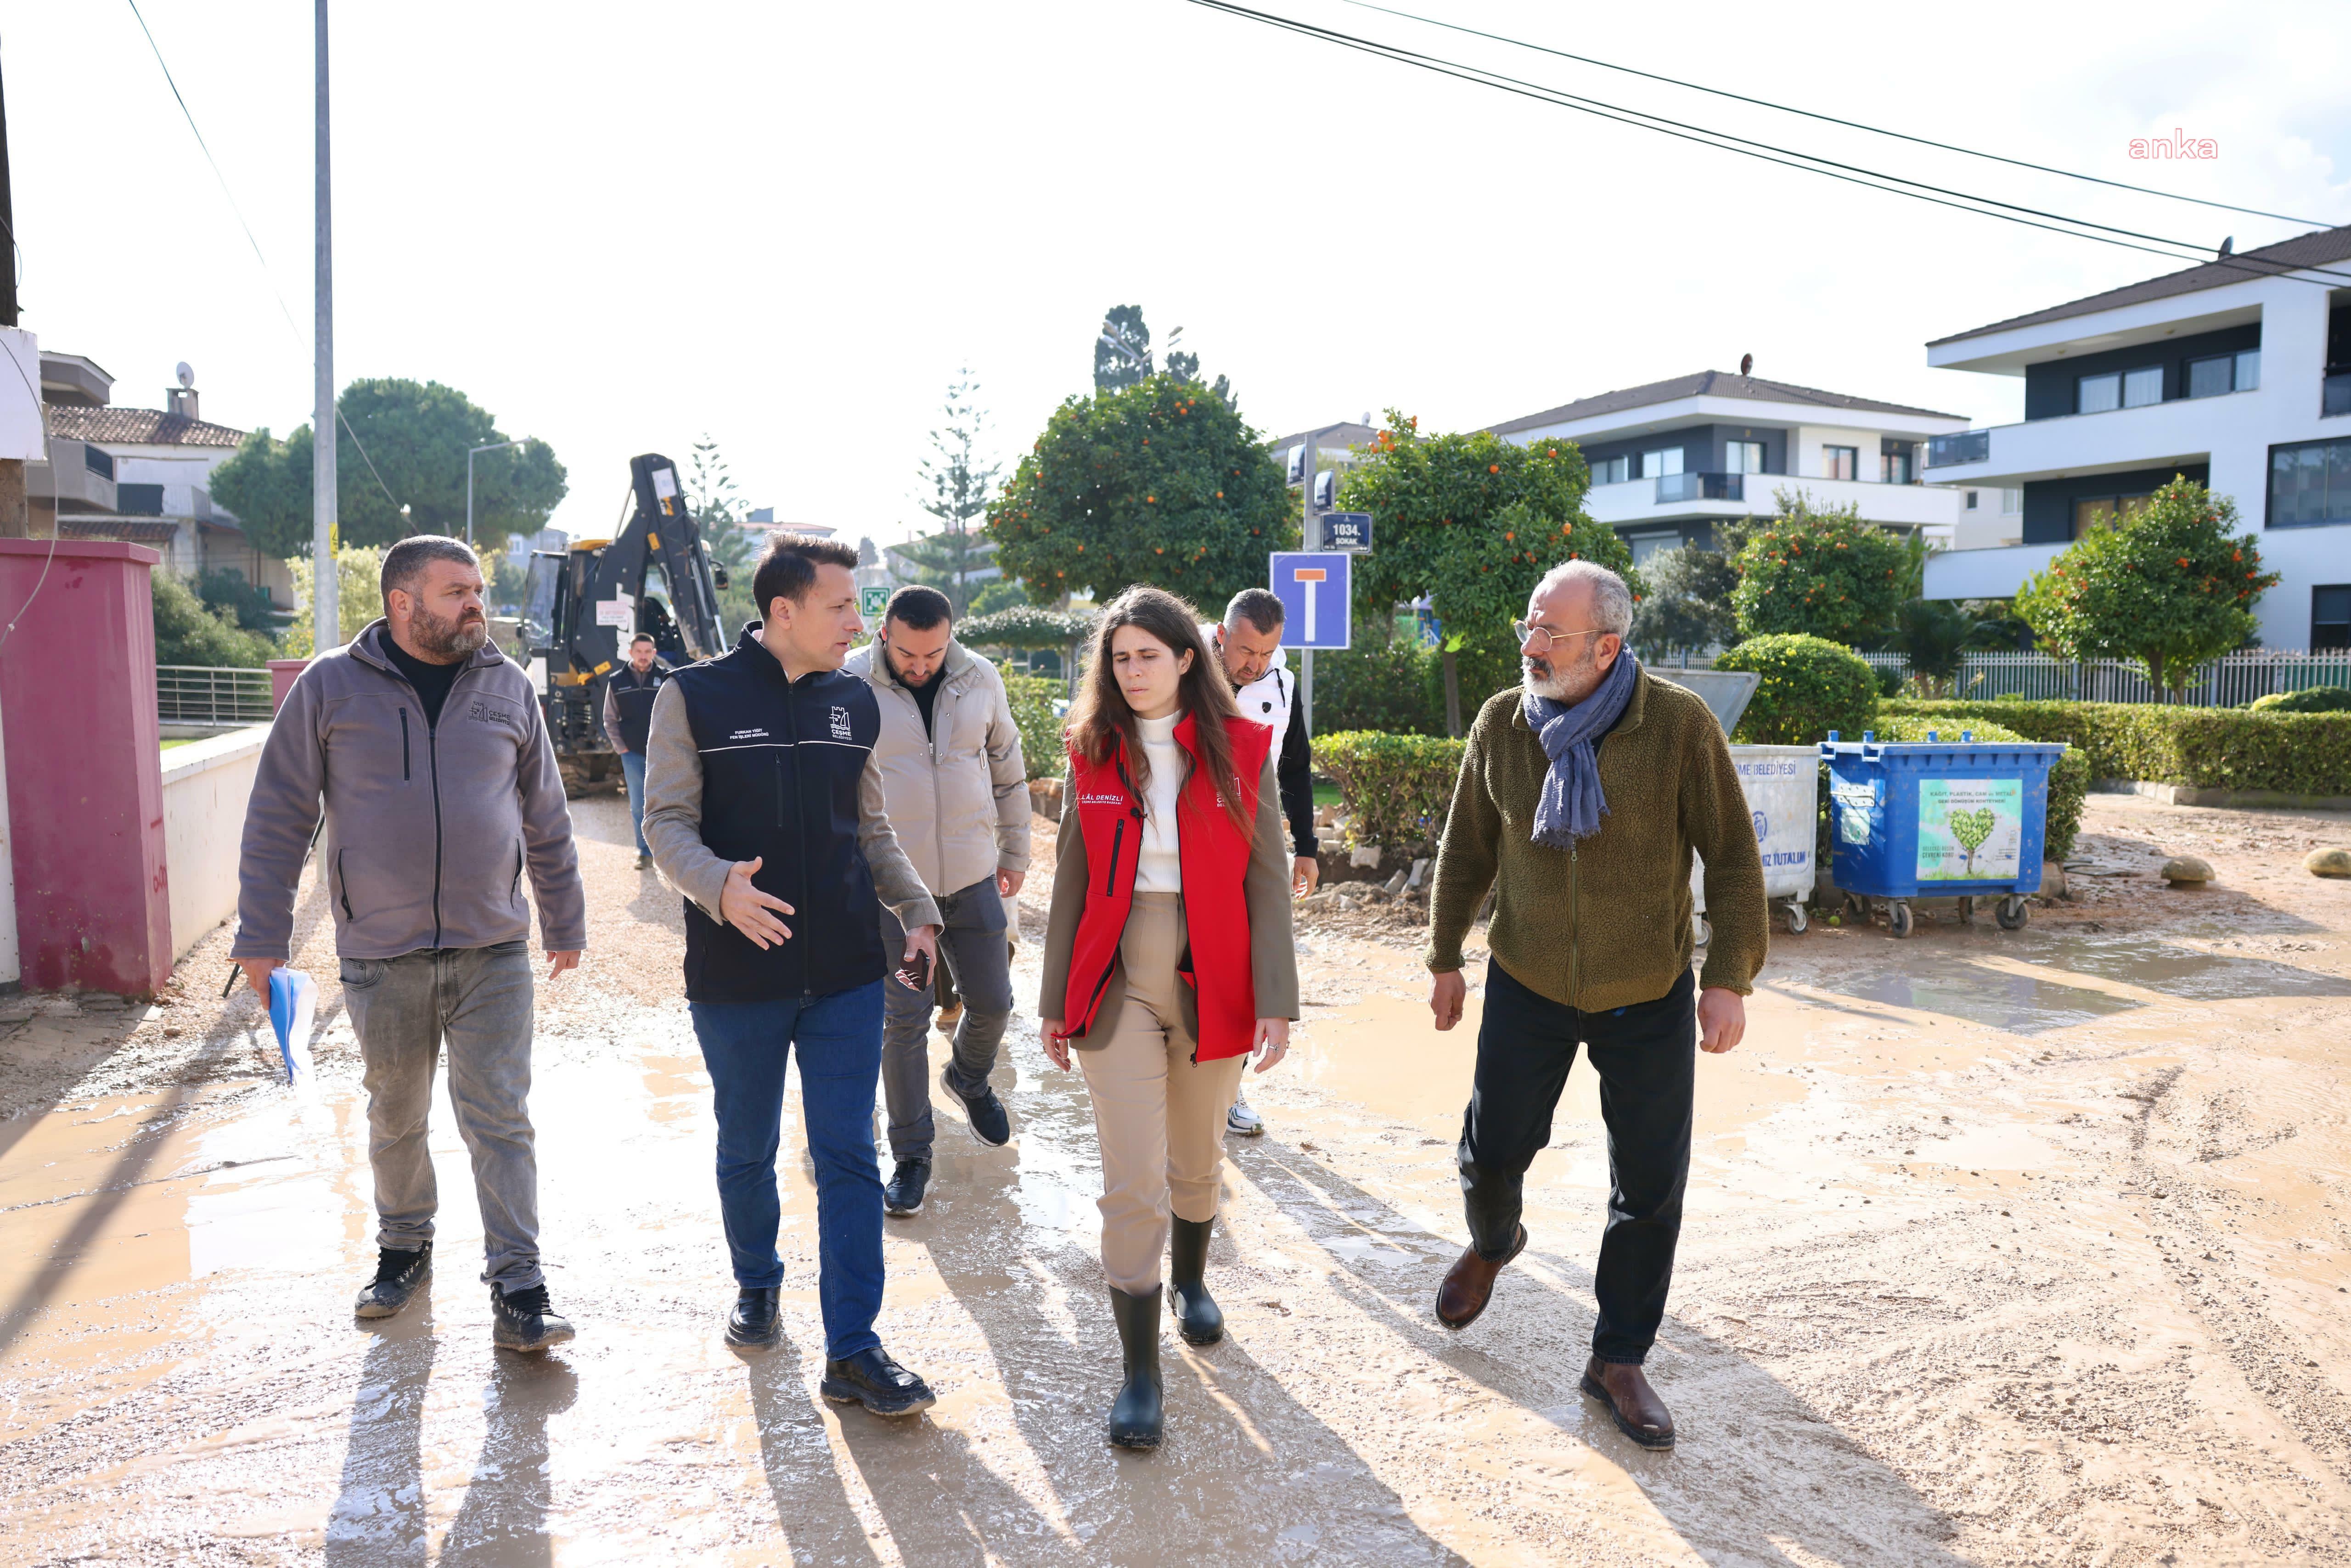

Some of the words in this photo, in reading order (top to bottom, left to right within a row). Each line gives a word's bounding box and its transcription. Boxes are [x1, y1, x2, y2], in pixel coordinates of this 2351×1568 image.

[1333, 524, 1361, 536] 1034.
[489, 711, 510, 720] ÇEŞME
[1754, 760, 1796, 776] BELEDİYESİ
[1773, 851, 1805, 865] TUTALIM
